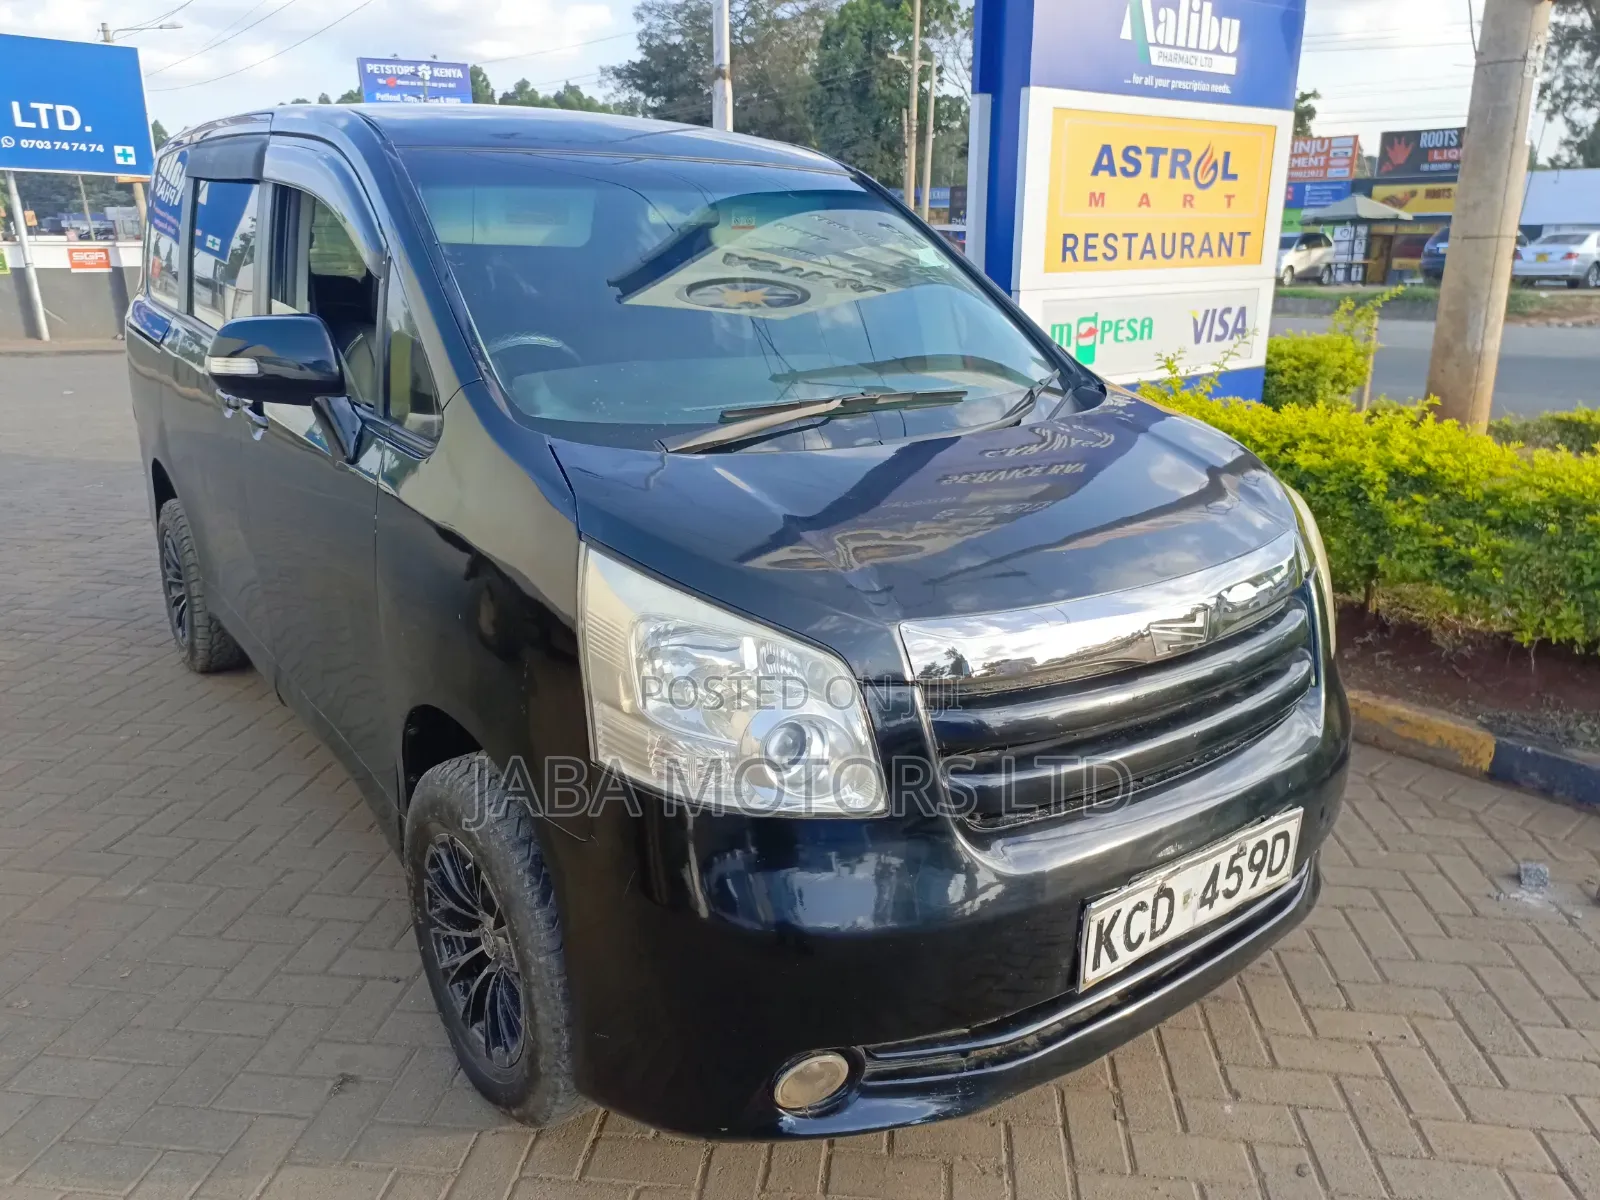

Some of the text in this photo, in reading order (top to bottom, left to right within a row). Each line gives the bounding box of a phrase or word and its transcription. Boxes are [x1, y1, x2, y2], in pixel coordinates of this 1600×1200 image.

[1157, 51, 1213, 68] PHARMACY LTD
[366, 63, 463, 79] PETSTORE KENYA
[1132, 72, 1144, 85] for
[1144, 75, 1154, 86] all
[1154, 77, 1171, 89] your
[1171, 80, 1210, 92] prescription
[11, 100, 92, 132] LTD.
[20, 138, 105, 153] 0703 74 74 74
[1291, 138, 1329, 155] INJU
[1420, 129, 1458, 149] ROOTS
[1289, 156, 1327, 168] MENT
[1433, 148, 1463, 160] LIQ
[1061, 231, 1251, 263] RESTAURANT
[72, 251, 106, 261] SGA
[1189, 306, 1246, 345] VISA
[1091, 830, 1291, 973] KCD 459D
